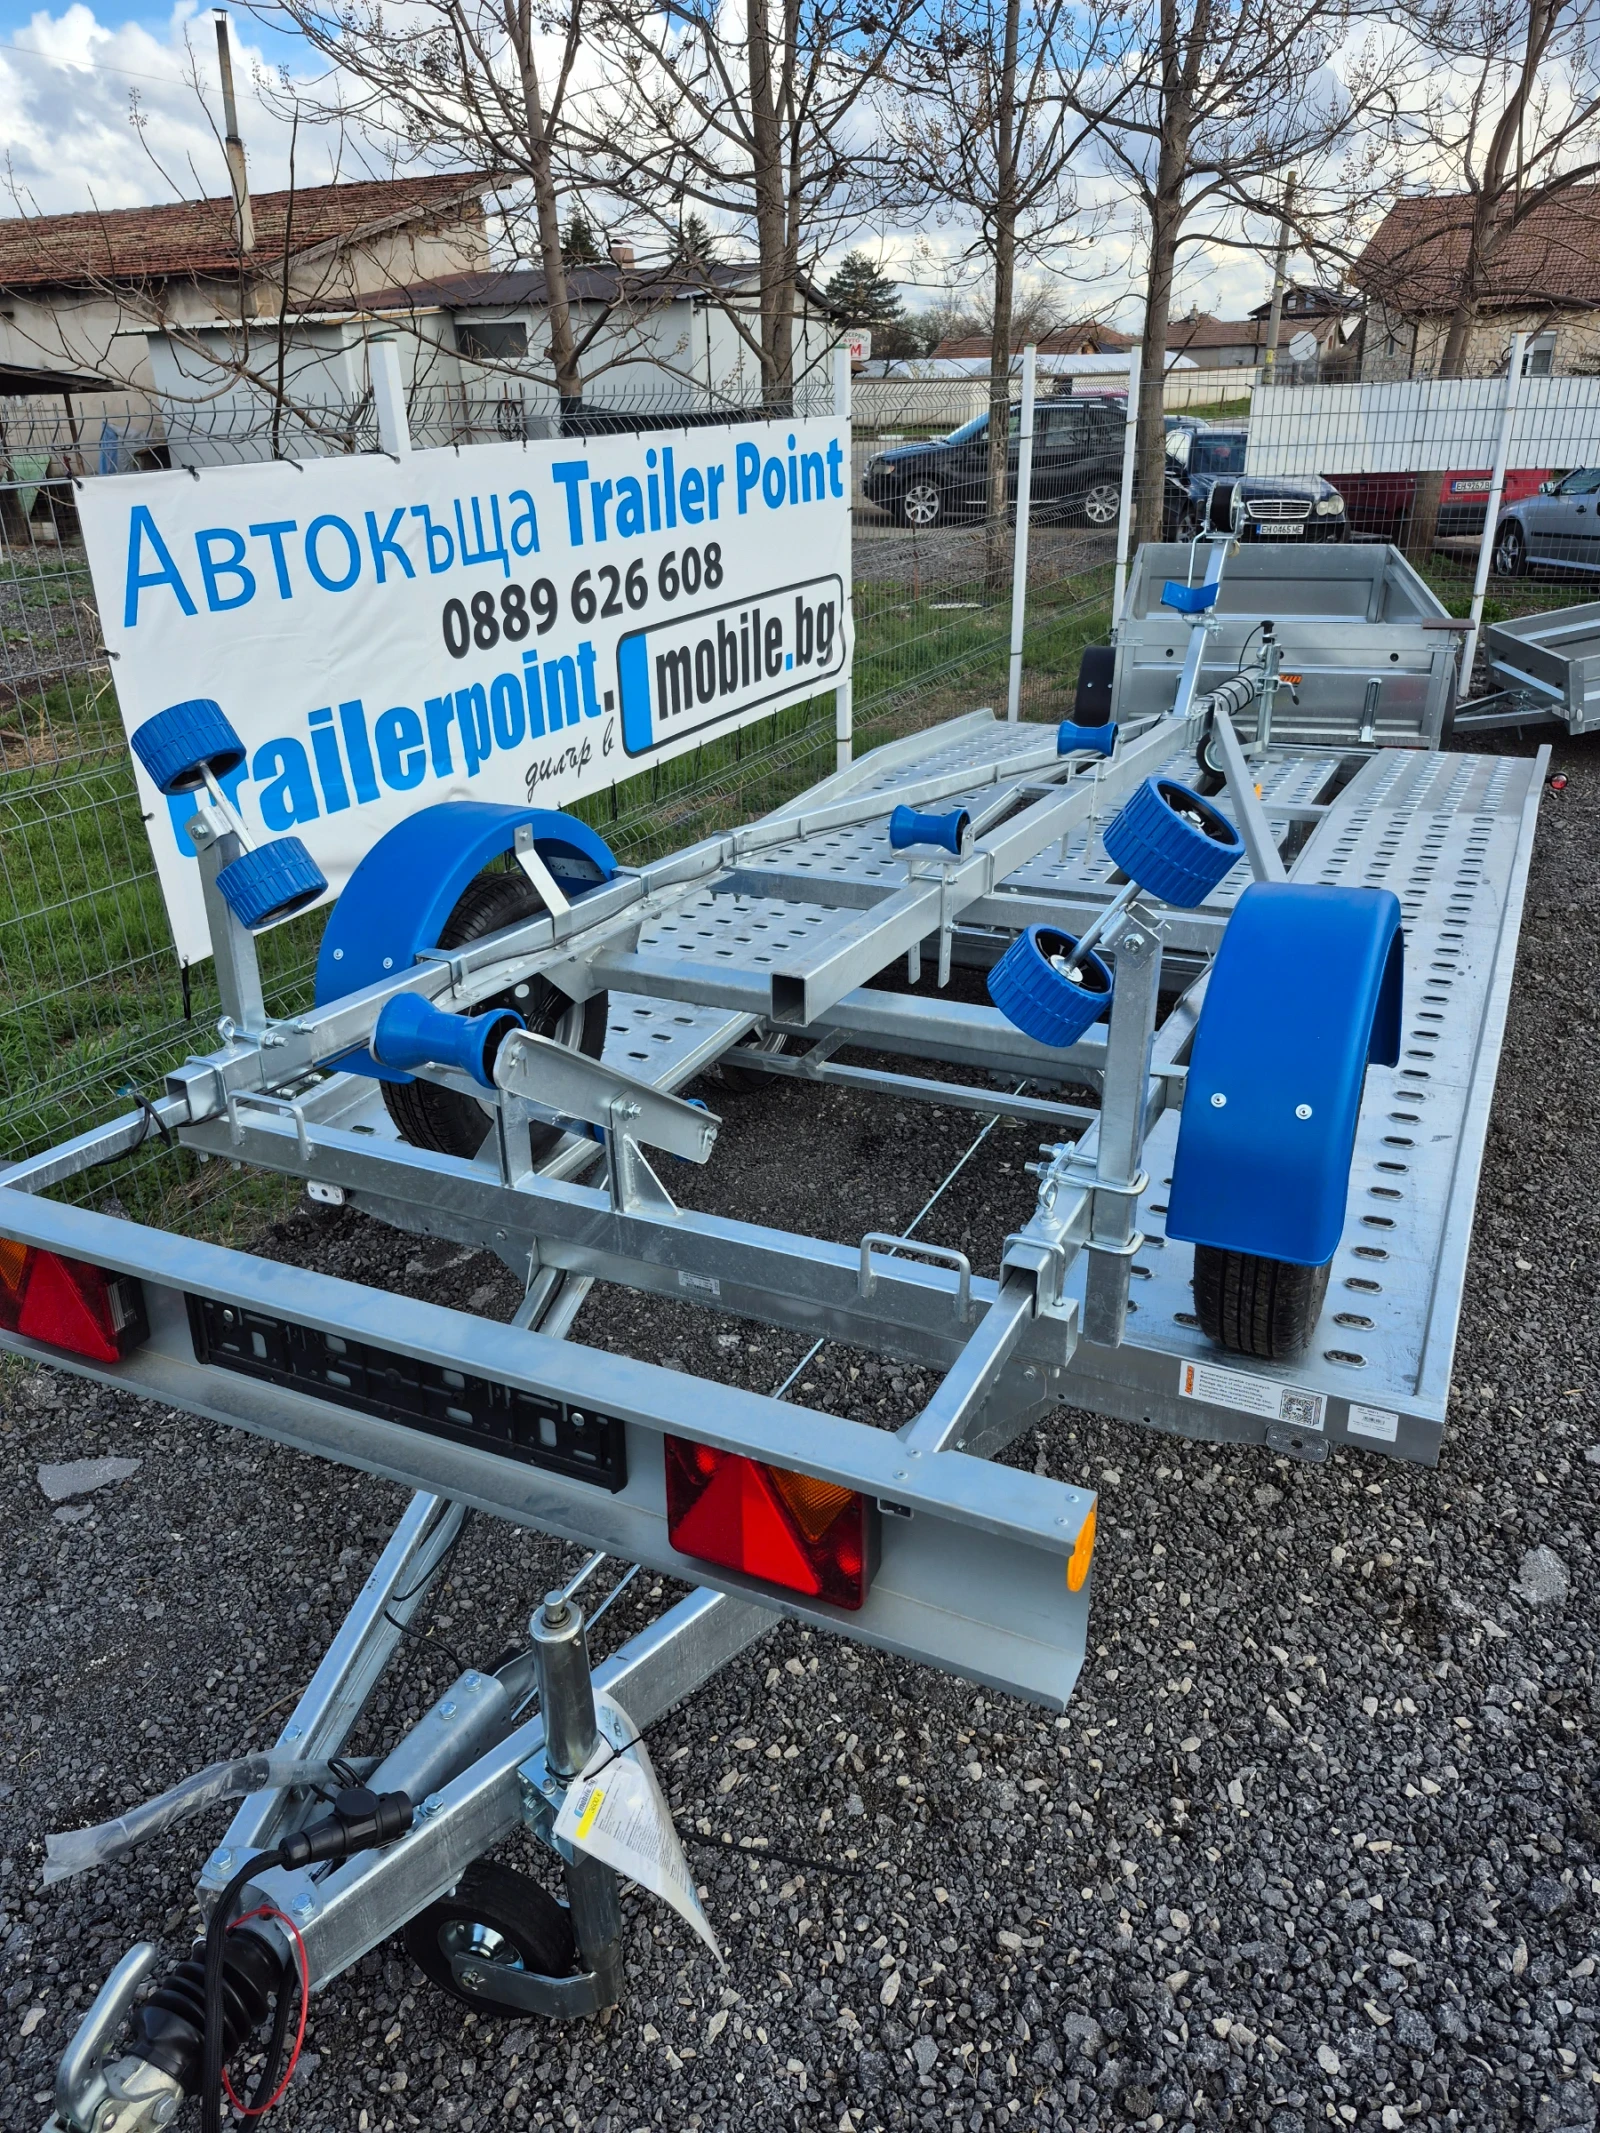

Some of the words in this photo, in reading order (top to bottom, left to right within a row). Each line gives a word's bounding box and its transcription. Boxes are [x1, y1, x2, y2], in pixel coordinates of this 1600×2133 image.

[123, 489, 541, 628] Автокъща
[551, 446, 725, 547] Trailer
[735, 433, 844, 515] Point
[442, 597, 558, 659] 0889
[571, 558, 649, 625] 626
[658, 541, 724, 601] 608
[655, 595, 836, 722] mobile.bg
